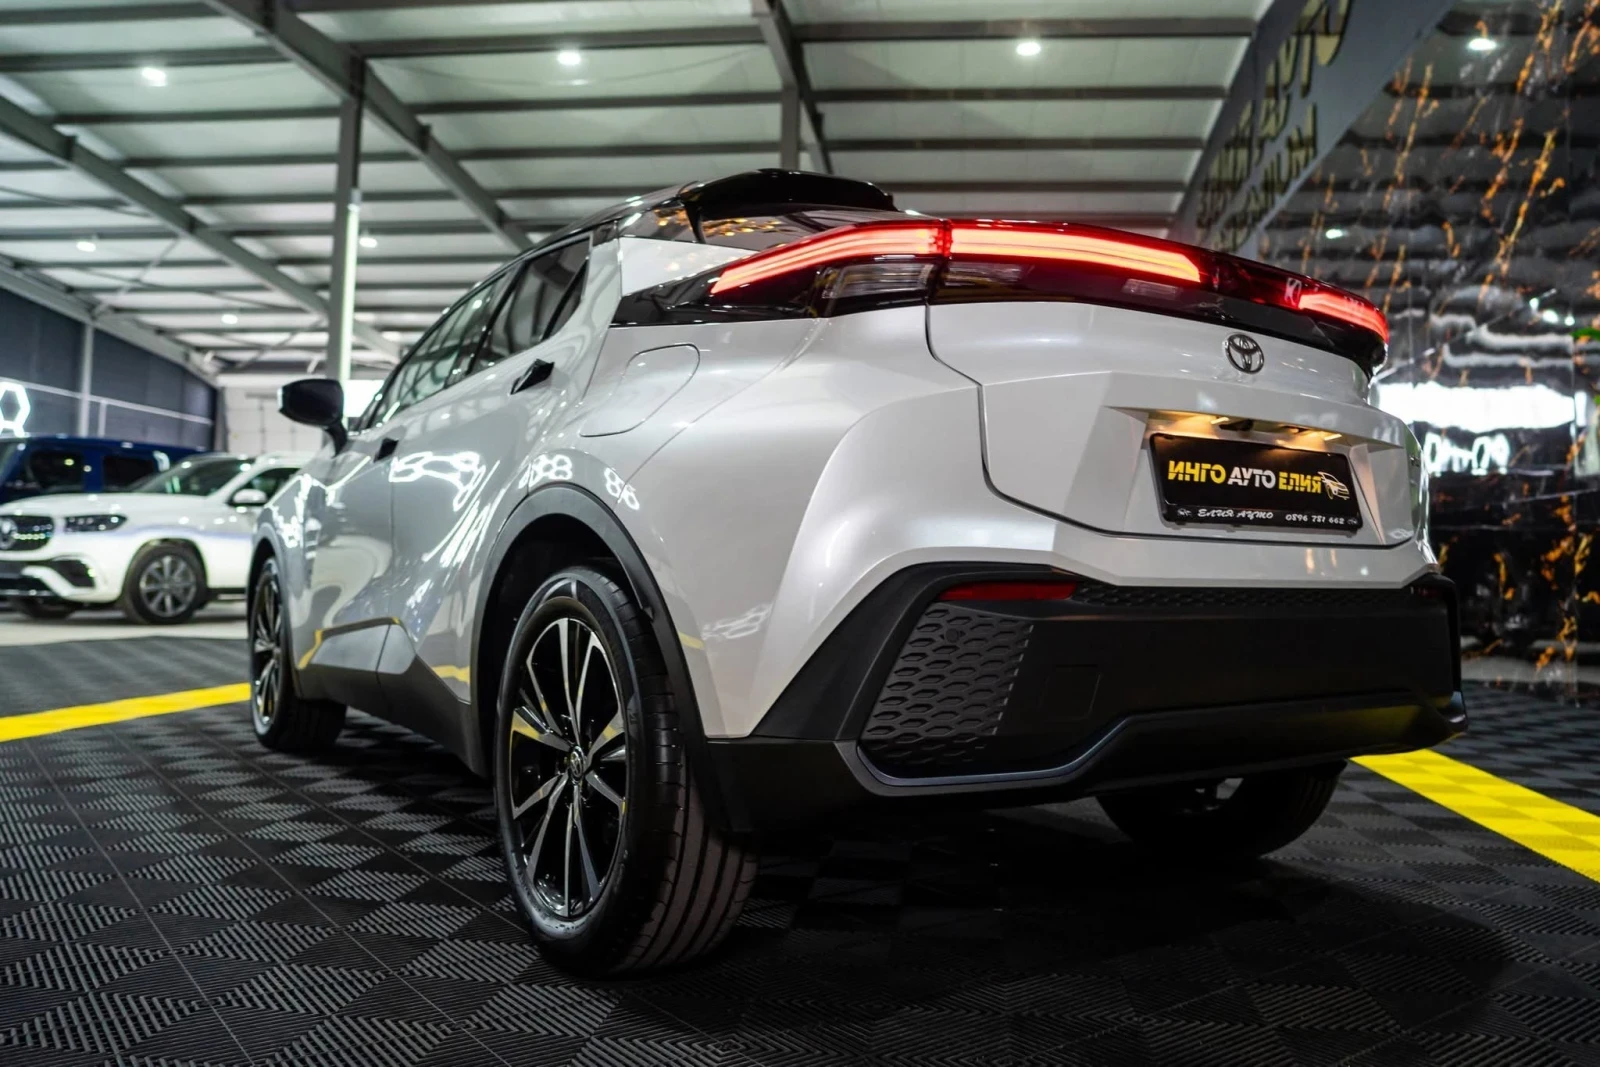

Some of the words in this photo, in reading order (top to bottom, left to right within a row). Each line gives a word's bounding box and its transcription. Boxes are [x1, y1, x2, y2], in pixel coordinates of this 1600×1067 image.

[1168, 460, 1226, 484] ИНГО
[1227, 466, 1276, 489] АУТО
[1278, 471, 1322, 494] ЕЛИЯ
